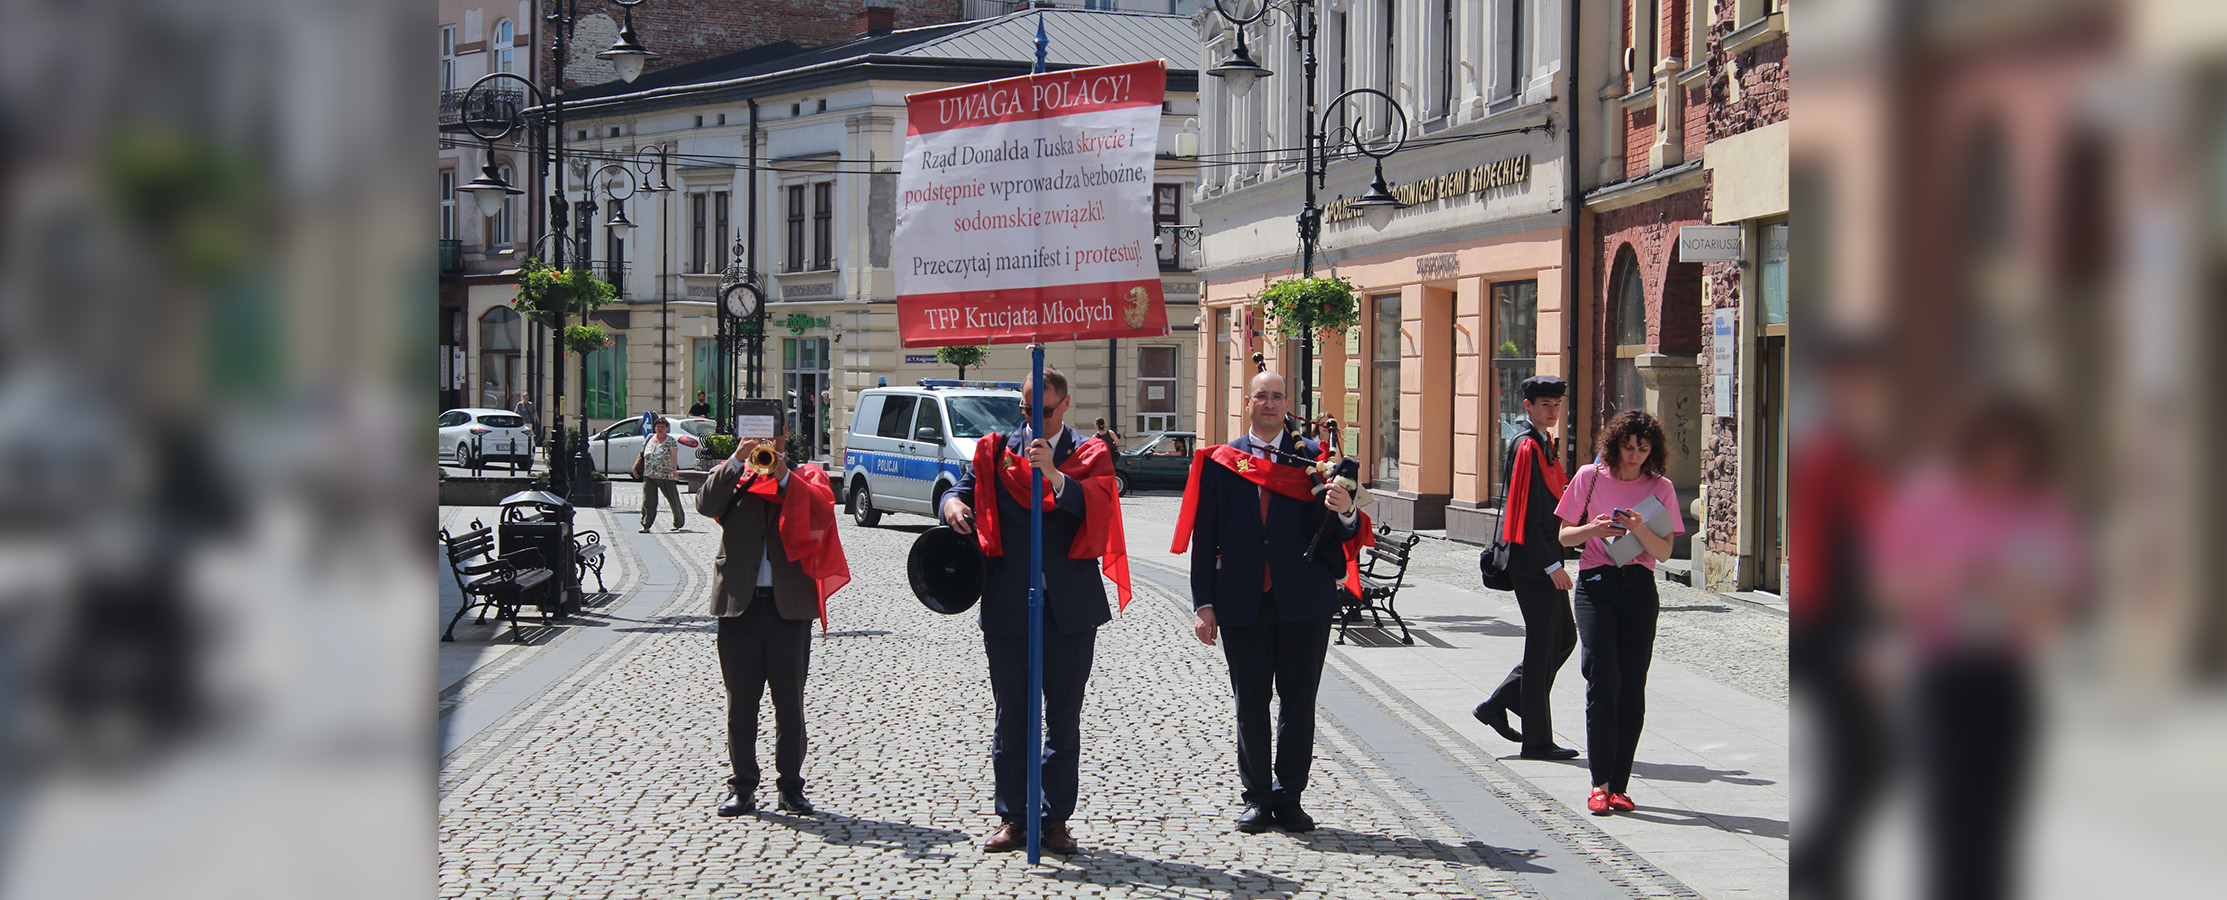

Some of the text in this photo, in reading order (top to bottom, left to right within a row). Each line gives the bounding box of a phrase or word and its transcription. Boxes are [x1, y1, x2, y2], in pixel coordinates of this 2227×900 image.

[939, 74, 1131, 124] UWAGA POLACY!
[922, 127, 1135, 173] Rząd Donalda Tuska skrycie i
[904, 164, 1147, 210] podstępnie wprowadza bezbożne,
[1440, 169, 1467, 199] ZIEMI
[954, 200, 1105, 232] sodomskie związki!
[912, 240, 1142, 279] Przeczytaj manifest i protestuj!
[1682, 238, 1740, 250] NOTARIUSZ
[924, 297, 1114, 334] TFP Krucjata Młodych
[877, 458, 899, 473] POLICJA
